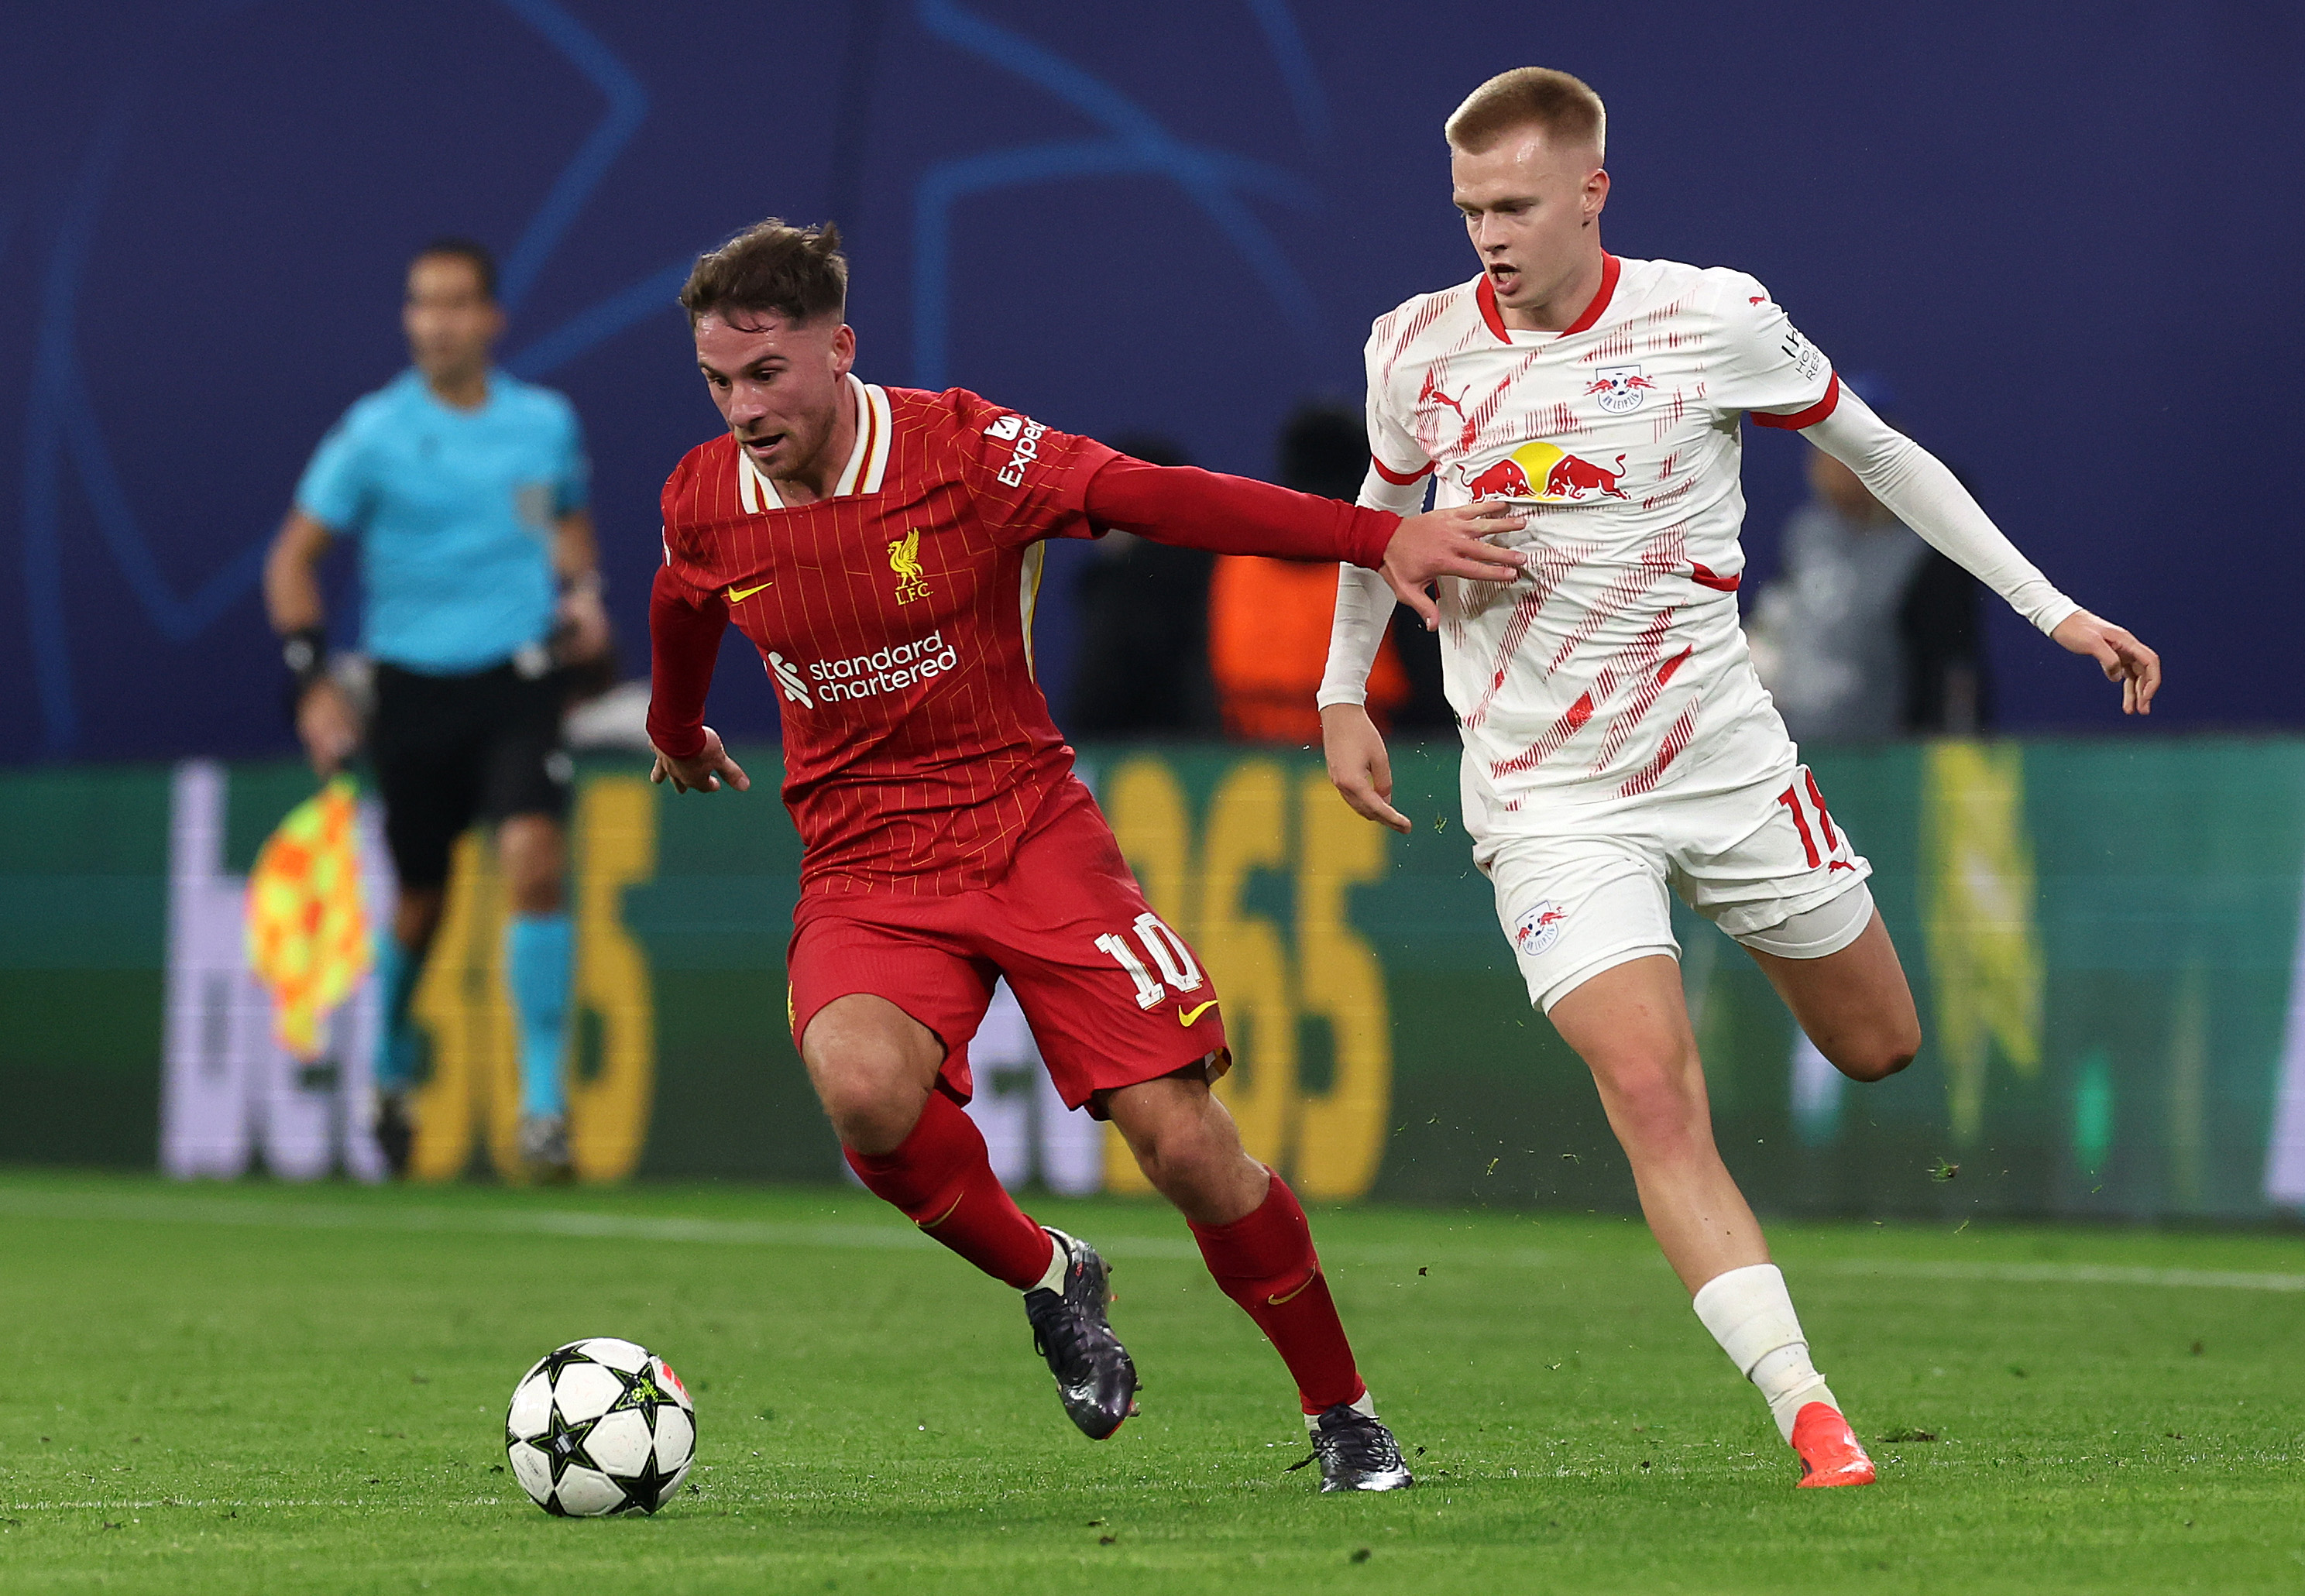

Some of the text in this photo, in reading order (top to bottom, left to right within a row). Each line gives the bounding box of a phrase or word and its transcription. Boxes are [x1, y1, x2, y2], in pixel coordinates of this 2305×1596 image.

[1805, 350, 1819, 381] RES
[1613, 393, 1639, 409] LEIPZIG
[997, 416, 1047, 488] Exped
[809, 630, 943, 681] standard
[818, 645, 957, 702] chartered
[1094, 912, 1204, 1011] 10
